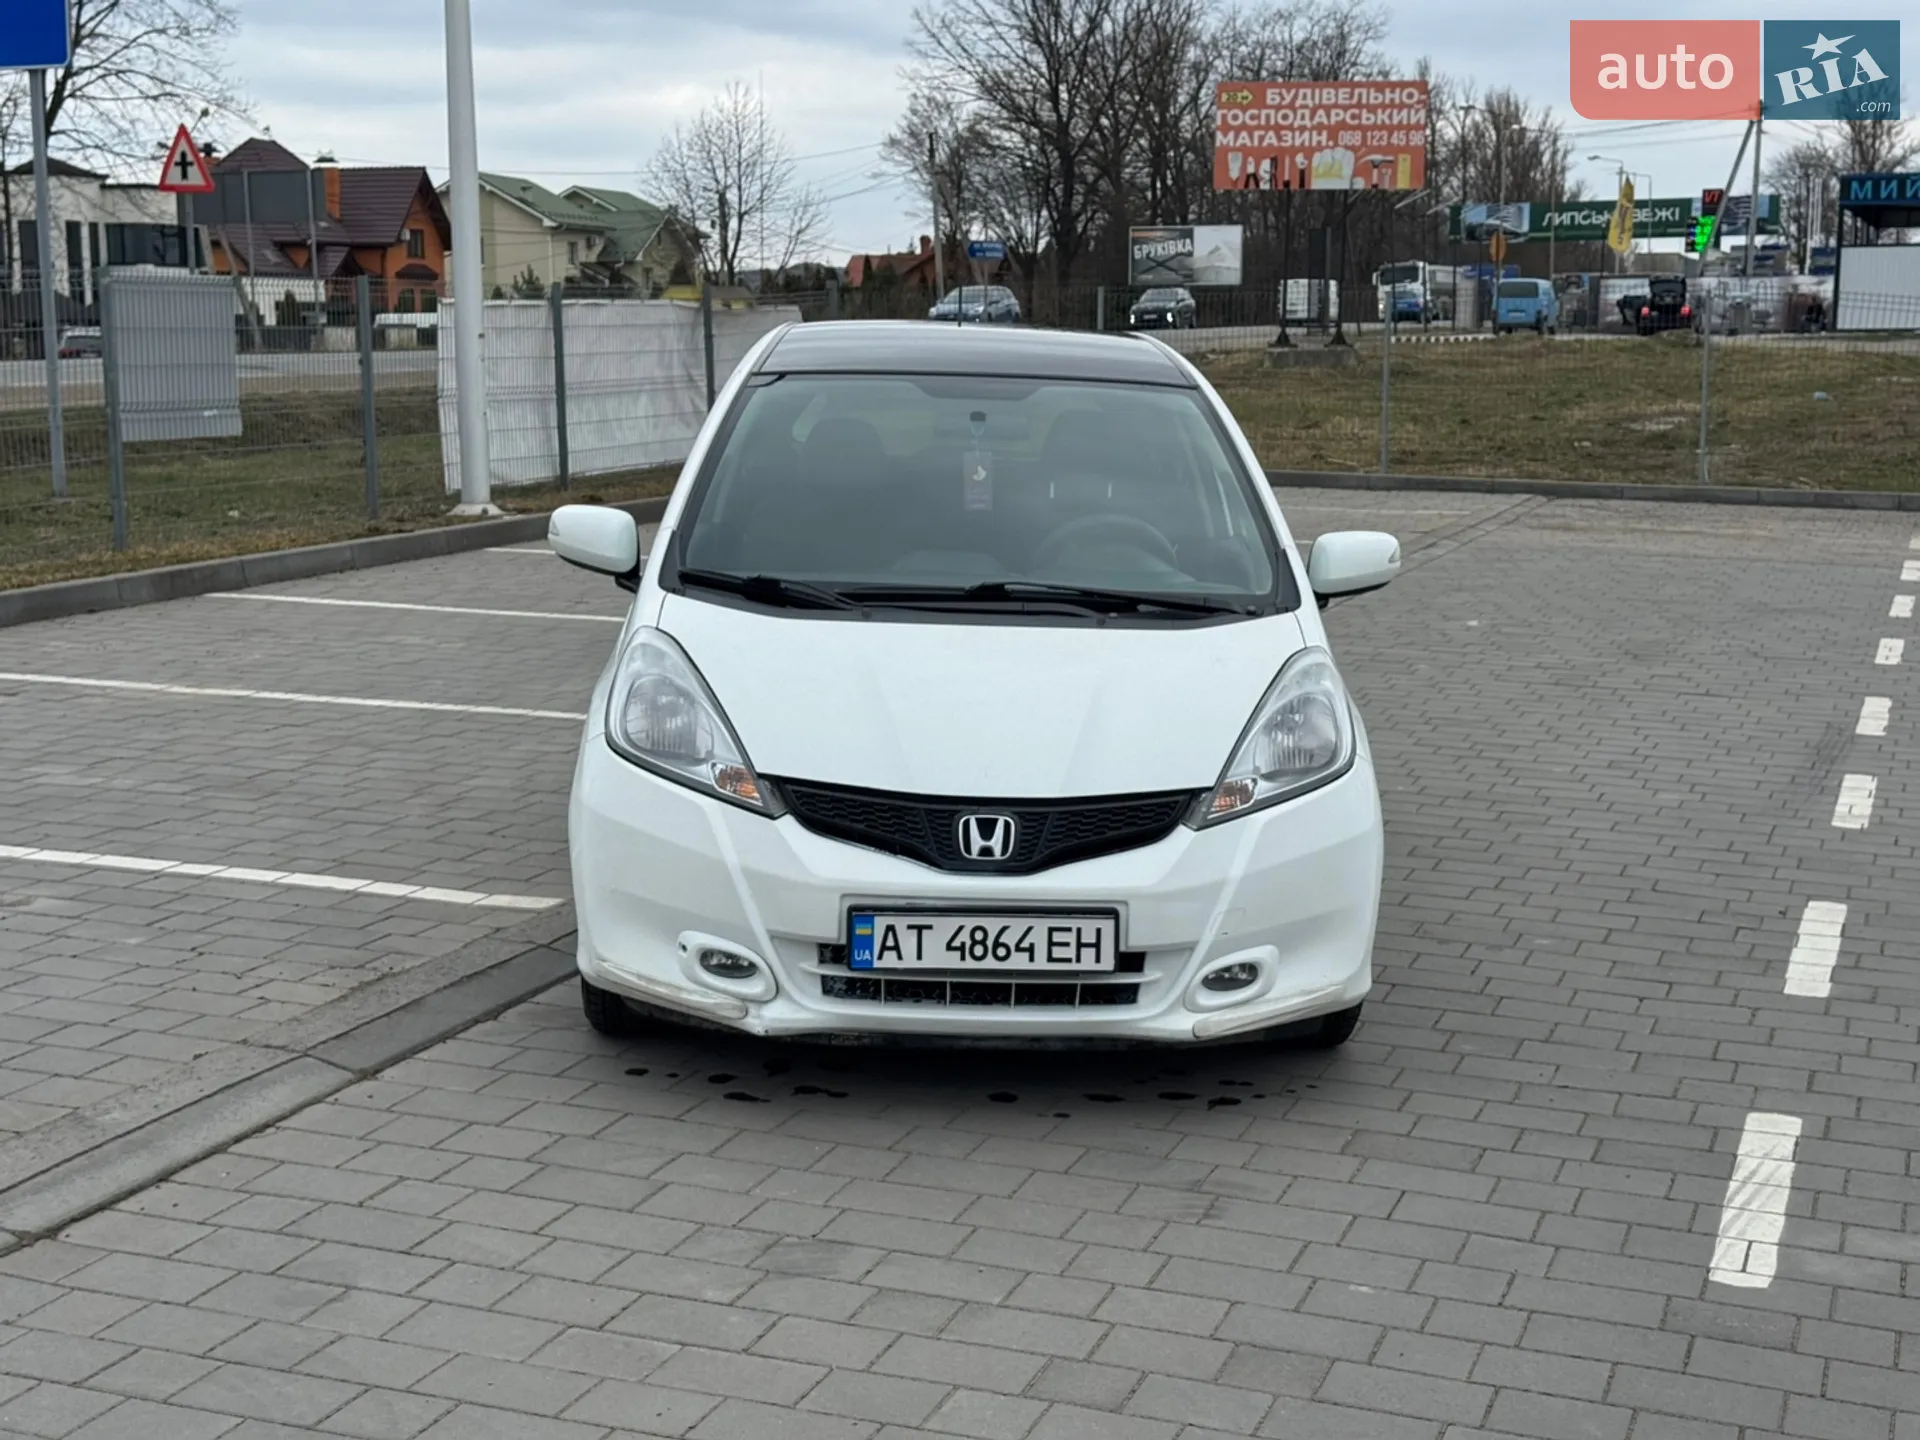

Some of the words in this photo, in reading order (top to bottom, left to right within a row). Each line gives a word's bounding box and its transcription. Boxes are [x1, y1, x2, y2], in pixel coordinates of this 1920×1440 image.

[1265, 87, 1427, 108] БУДІВЕЛЬНО-
[1216, 103, 1426, 129] ГОСПОДАРСЬКИЙ
[1215, 129, 1334, 147] МАГАЗИН.
[1366, 129, 1388, 146] 123
[1390, 129, 1407, 146] 45
[1133, 238, 1194, 260] БРУКІВКА
[876, 924, 934, 961] AT
[945, 924, 1035, 963] 4864
[1046, 926, 1102, 964] EH
[854, 949, 872, 961] UA
